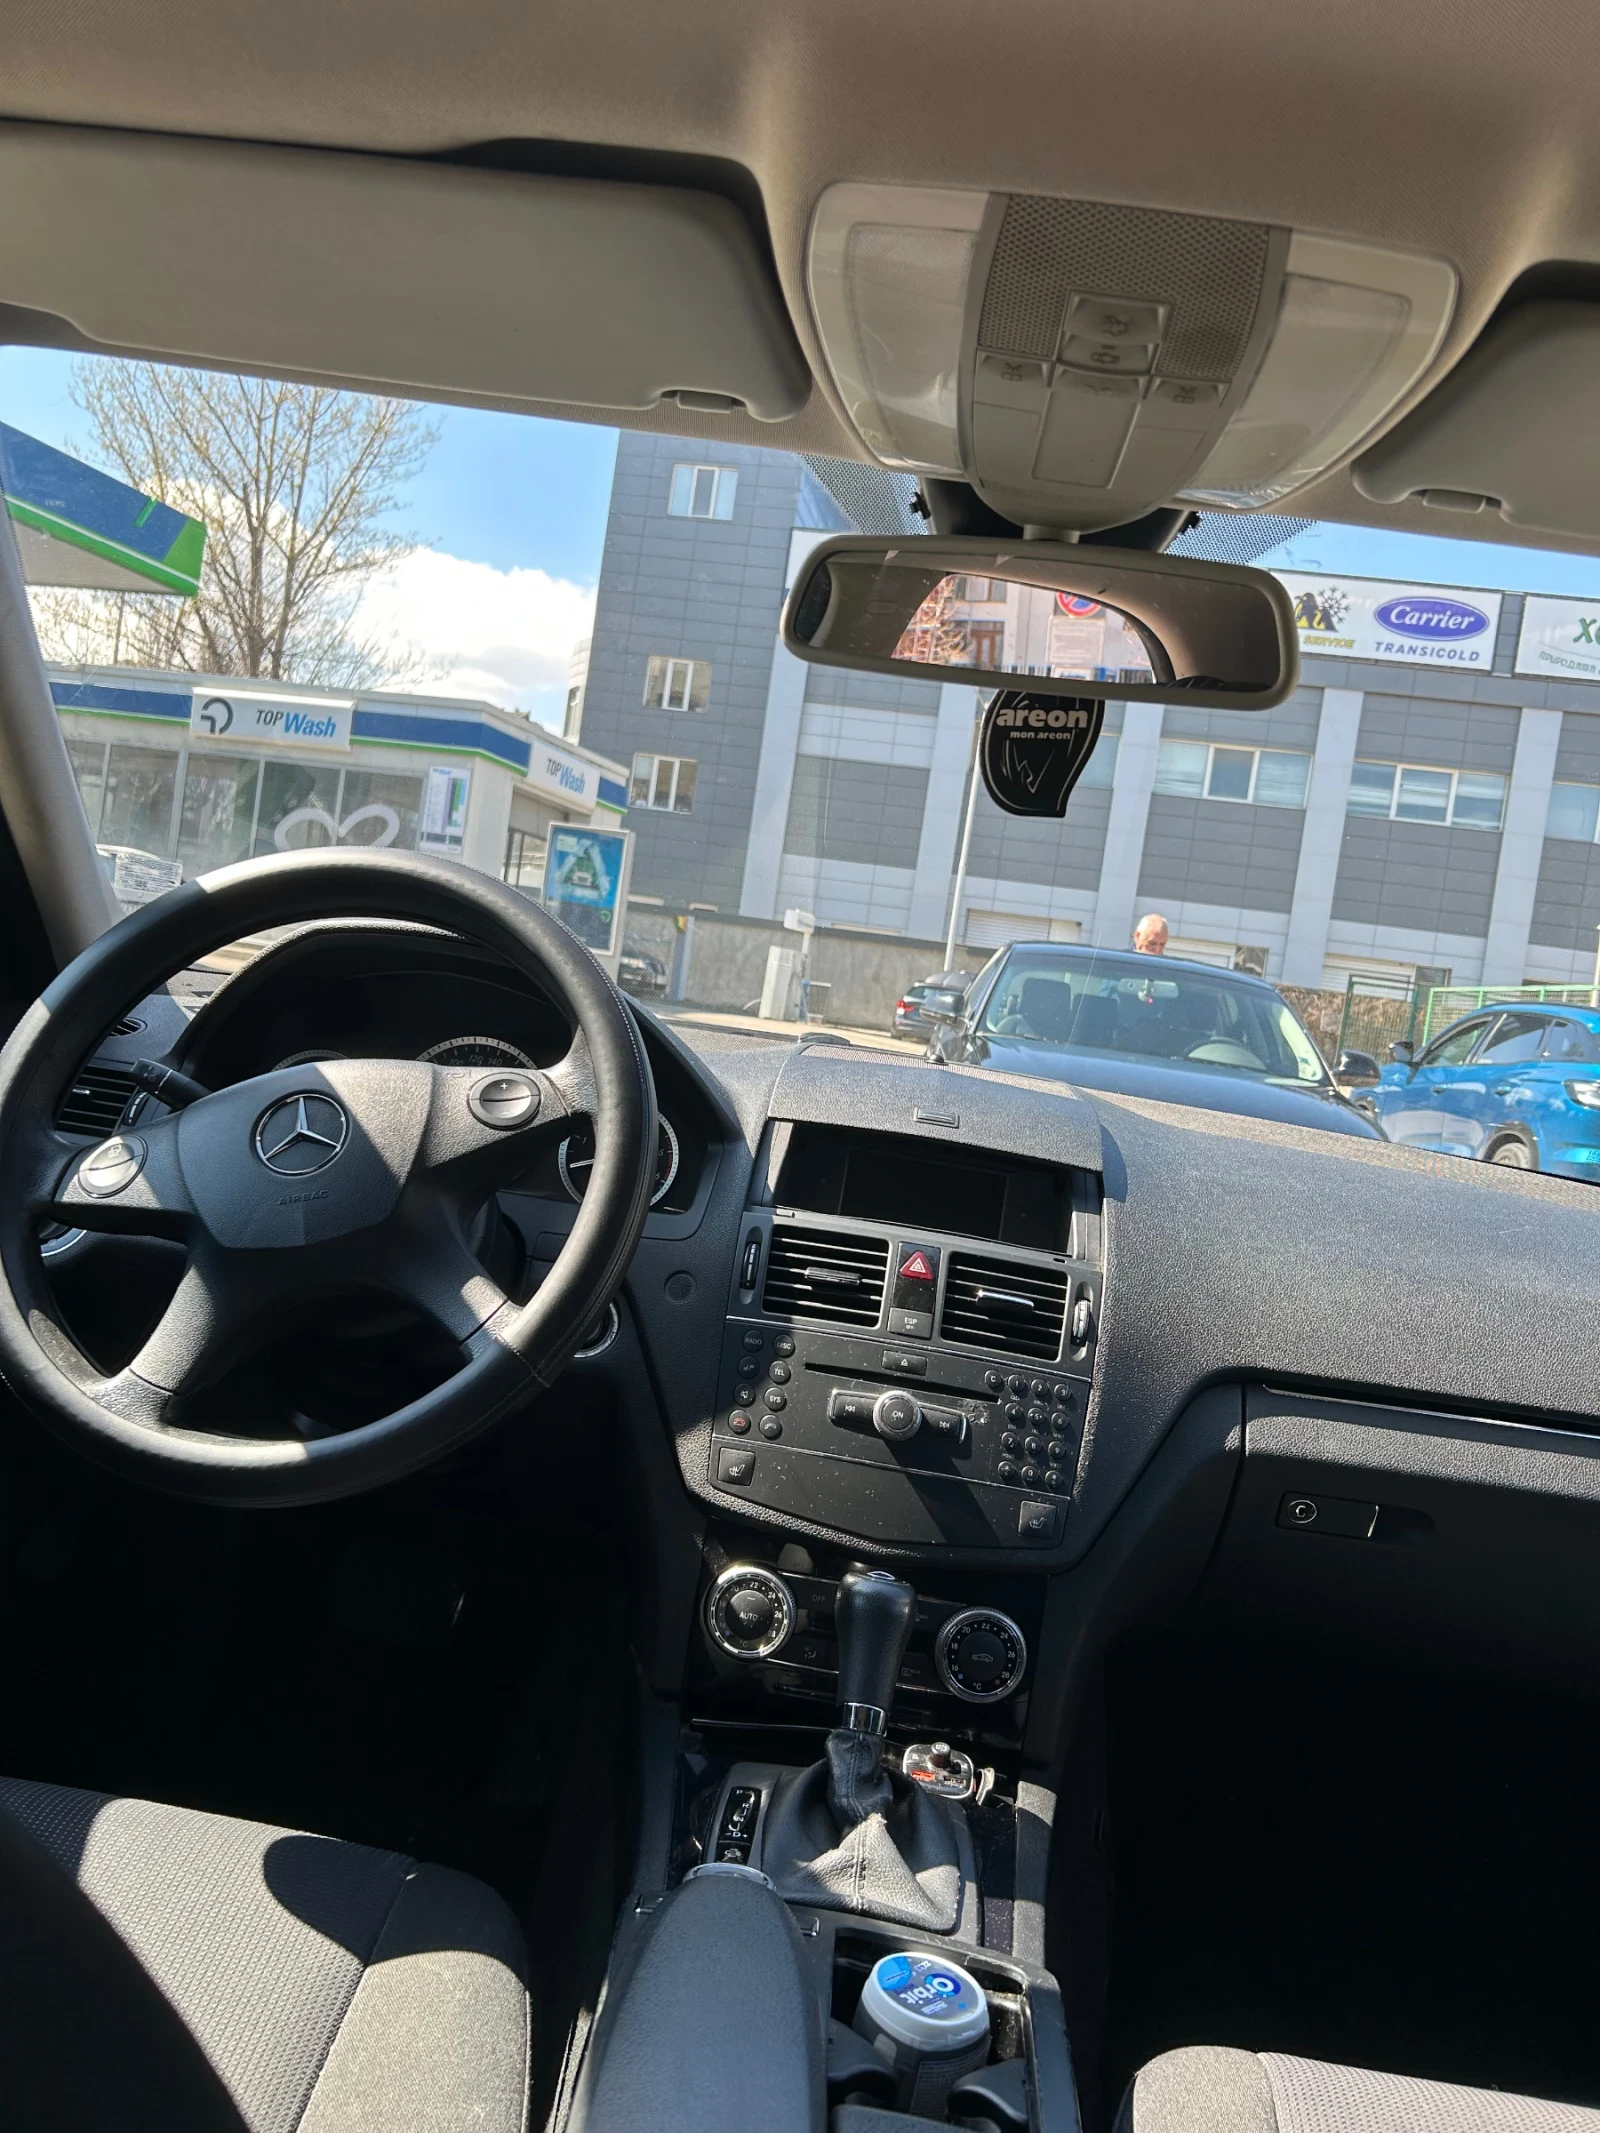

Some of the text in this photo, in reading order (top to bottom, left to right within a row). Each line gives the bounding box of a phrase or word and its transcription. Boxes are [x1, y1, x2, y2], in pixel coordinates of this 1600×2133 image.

[1389, 604, 1475, 630] Carrier
[1303, 634, 1356, 649] SERVICE
[1375, 641, 1480, 662] TRANSICOLD
[996, 708, 1088, 728] areon
[1010, 731, 1071, 740] mon areon
[278, 1190, 329, 1206] AIRBAG
[904, 1317, 918, 1325] ESP
[776, 1342, 792, 1350] DISC
[774, 1367, 785, 1376] TEL
[769, 1395, 781, 1403] SYS
[892, 1411, 904, 1419] ON
[750, 1581, 758, 1589] 22
[812, 1594, 826, 1602] OFF
[739, 1611, 759, 1621] AUTO
[774, 1611, 782, 1619] 26
[951, 1664, 959, 1672] 16
[1001, 1671, 1010, 1679] 28
[899, 1977, 955, 2005] Orbit
